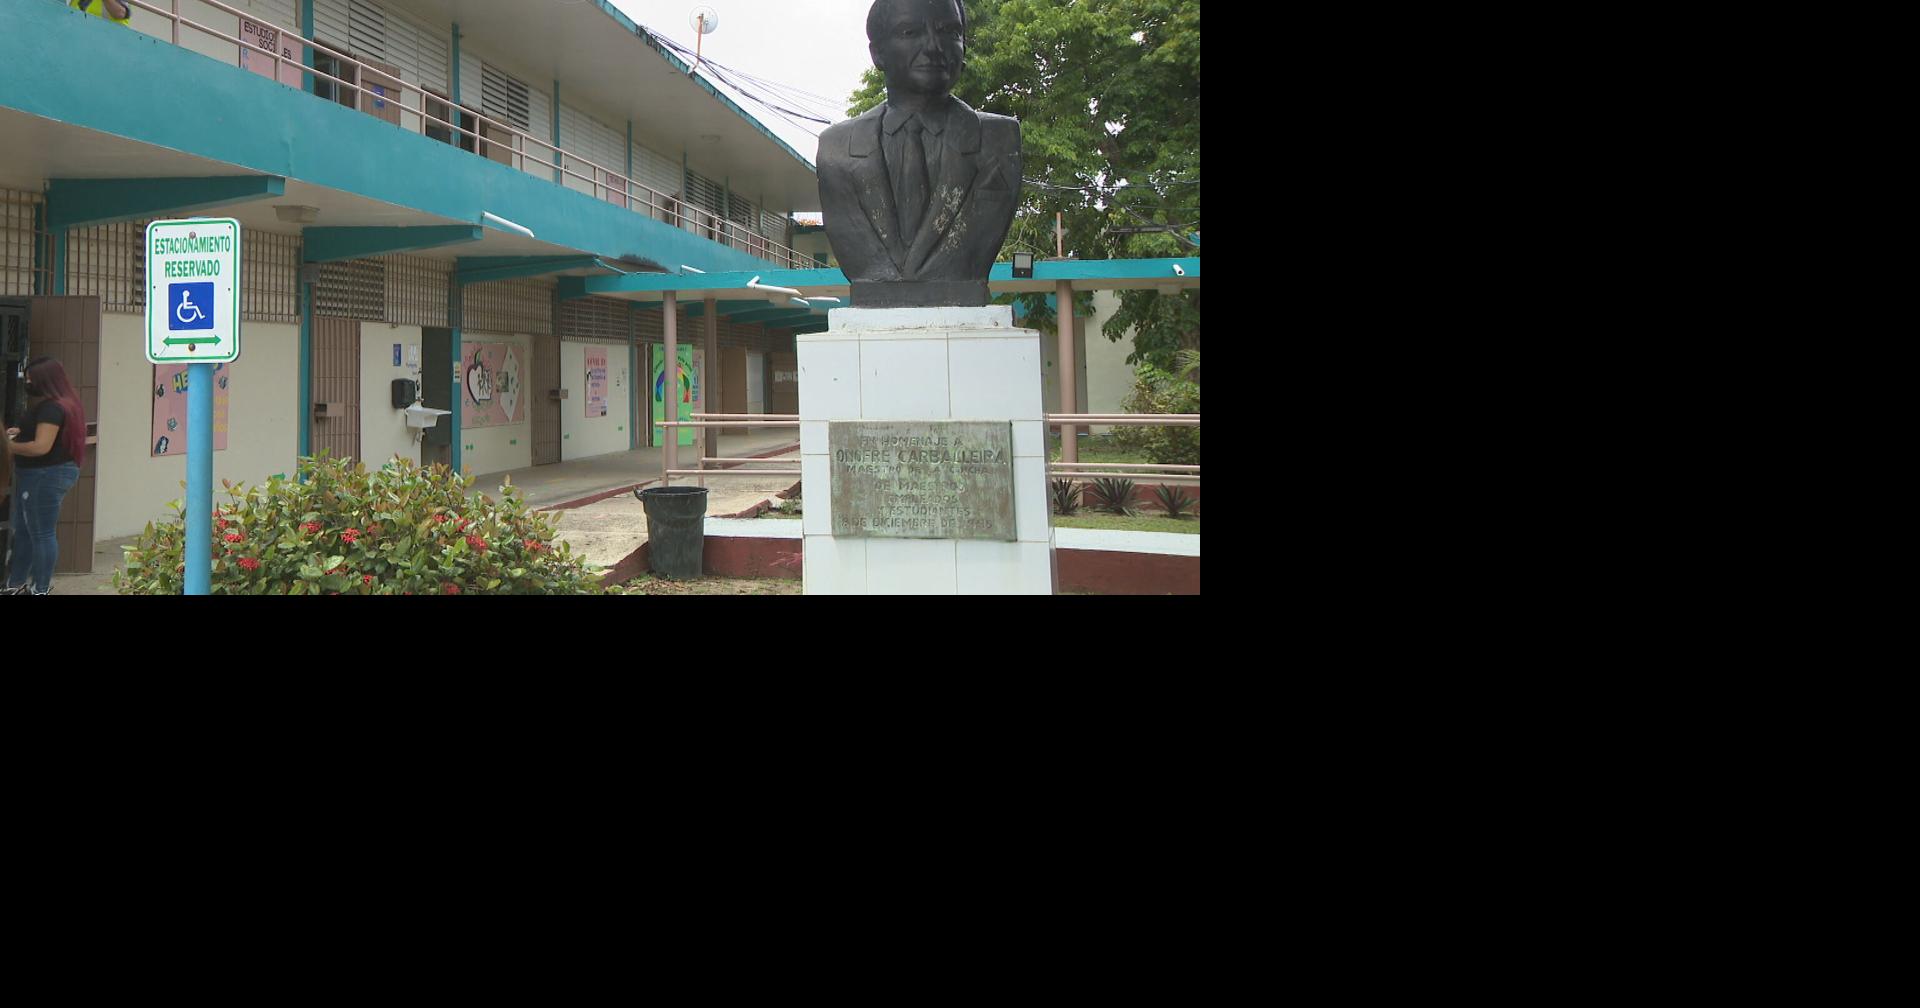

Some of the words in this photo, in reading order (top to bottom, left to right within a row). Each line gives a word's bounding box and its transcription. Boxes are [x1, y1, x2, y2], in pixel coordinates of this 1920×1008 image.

[244, 21, 275, 42] ESTUDIO
[154, 236, 231, 255] ESTACIONAMIENTO
[165, 260, 220, 278] RESERVADO
[880, 436, 948, 447] HOMENAJE
[953, 437, 963, 447] A
[836, 449, 890, 463] ONOFRE
[872, 518, 937, 529] DICIEMBRE
